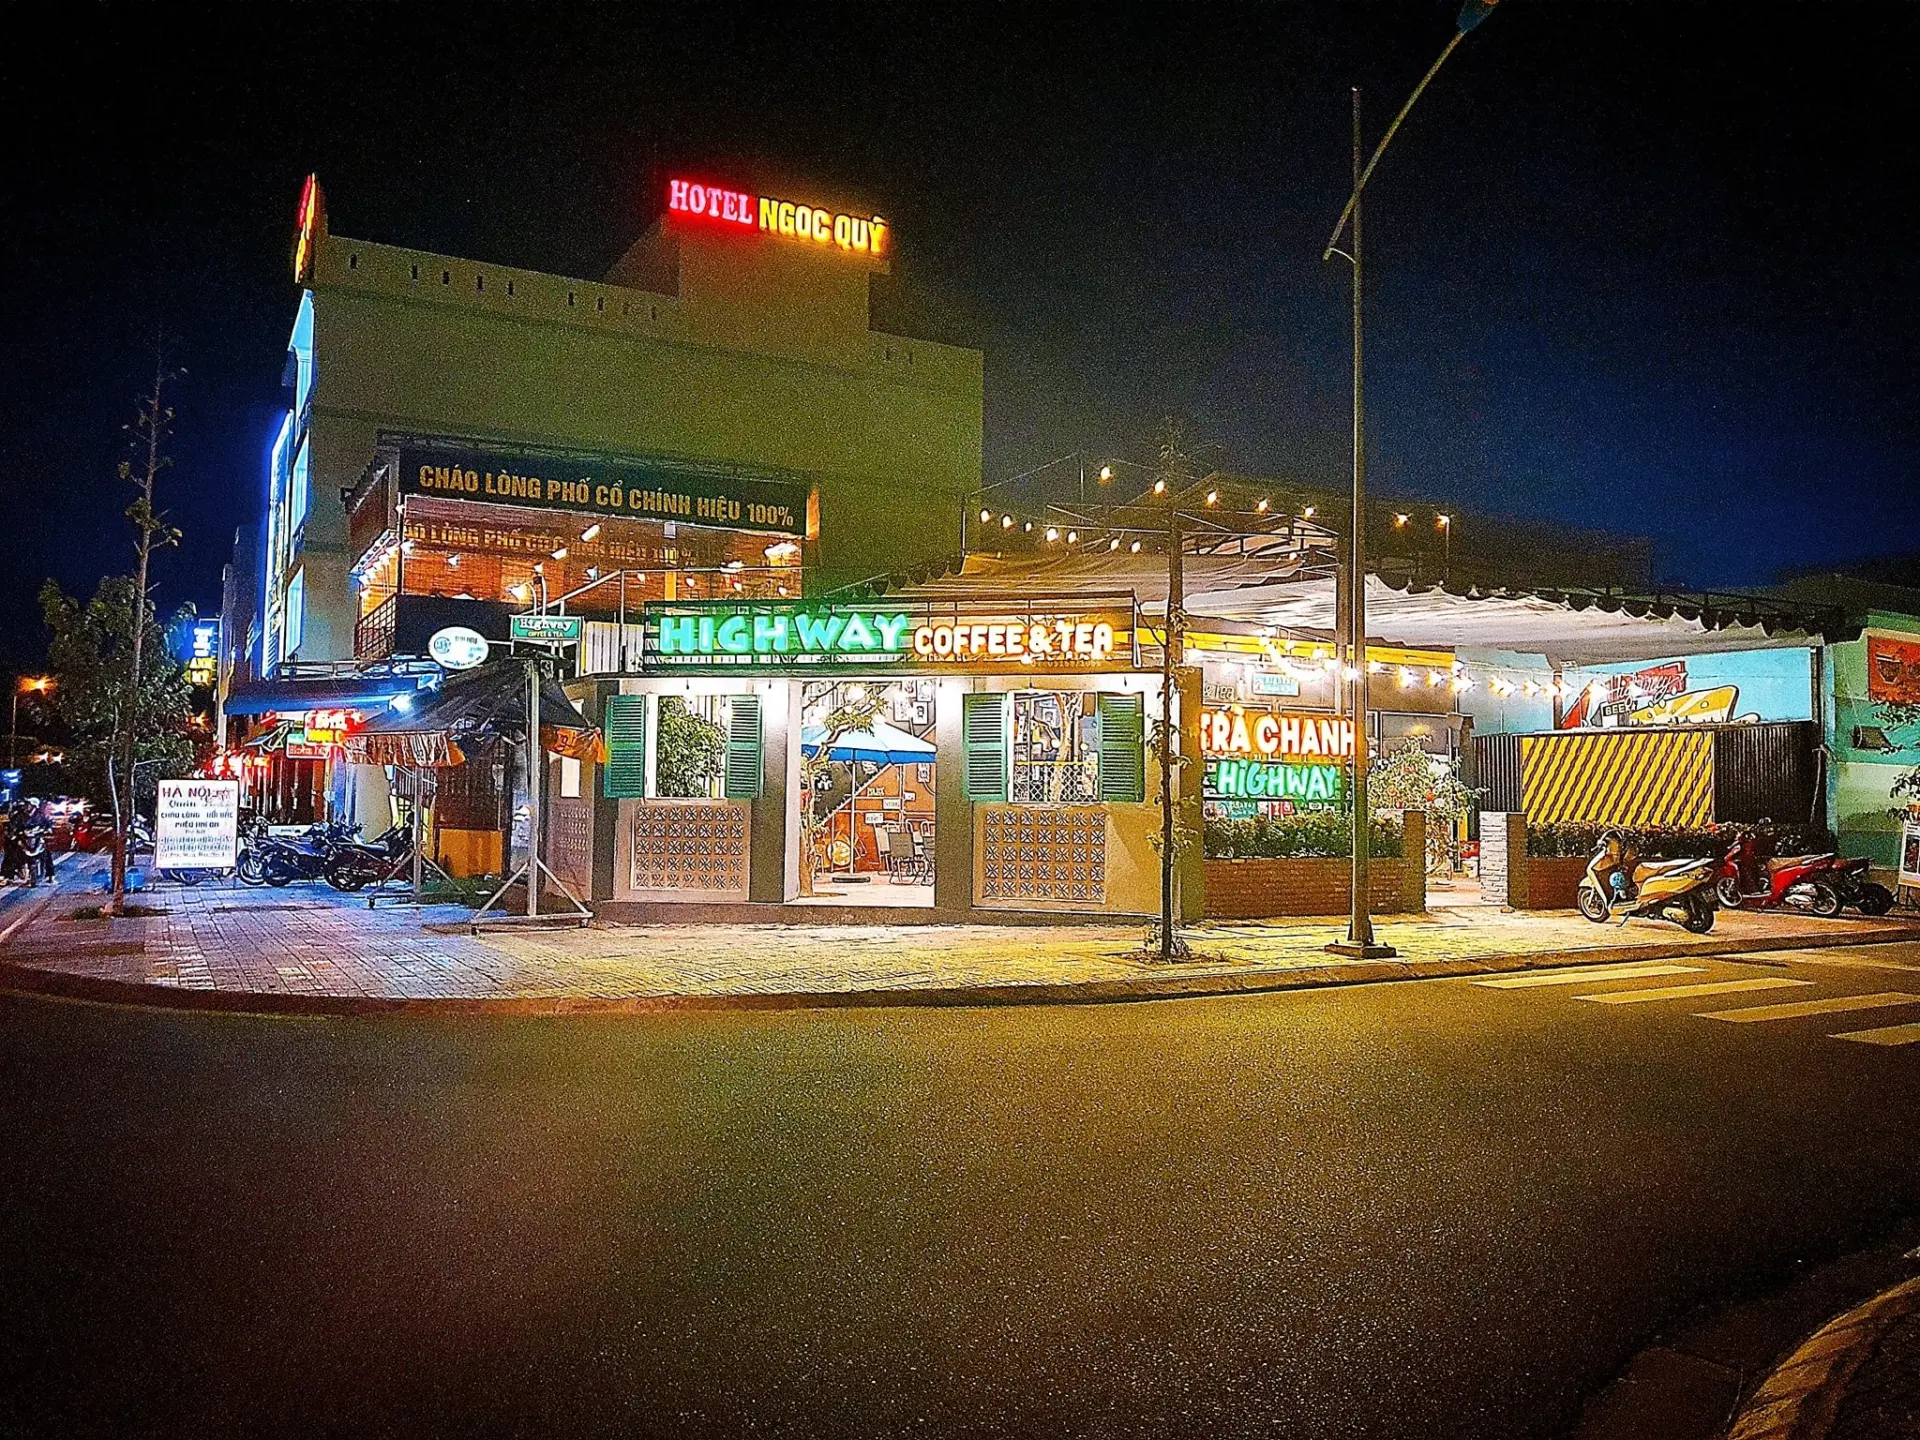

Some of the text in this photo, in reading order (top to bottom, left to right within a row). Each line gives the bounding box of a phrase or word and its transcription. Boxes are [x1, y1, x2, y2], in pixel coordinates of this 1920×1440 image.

[670, 179, 753, 225] HOTEL
[834, 215, 888, 254] QUÝ
[419, 464, 794, 527] CHÁO LÒNG PHỐ CỔ CHÍNH HIỆU 100%
[520, 618, 573, 631] Highway
[914, 625, 1025, 655] COFFEE
[1028, 624, 1053, 655] &
[1055, 620, 1114, 657] TEA
